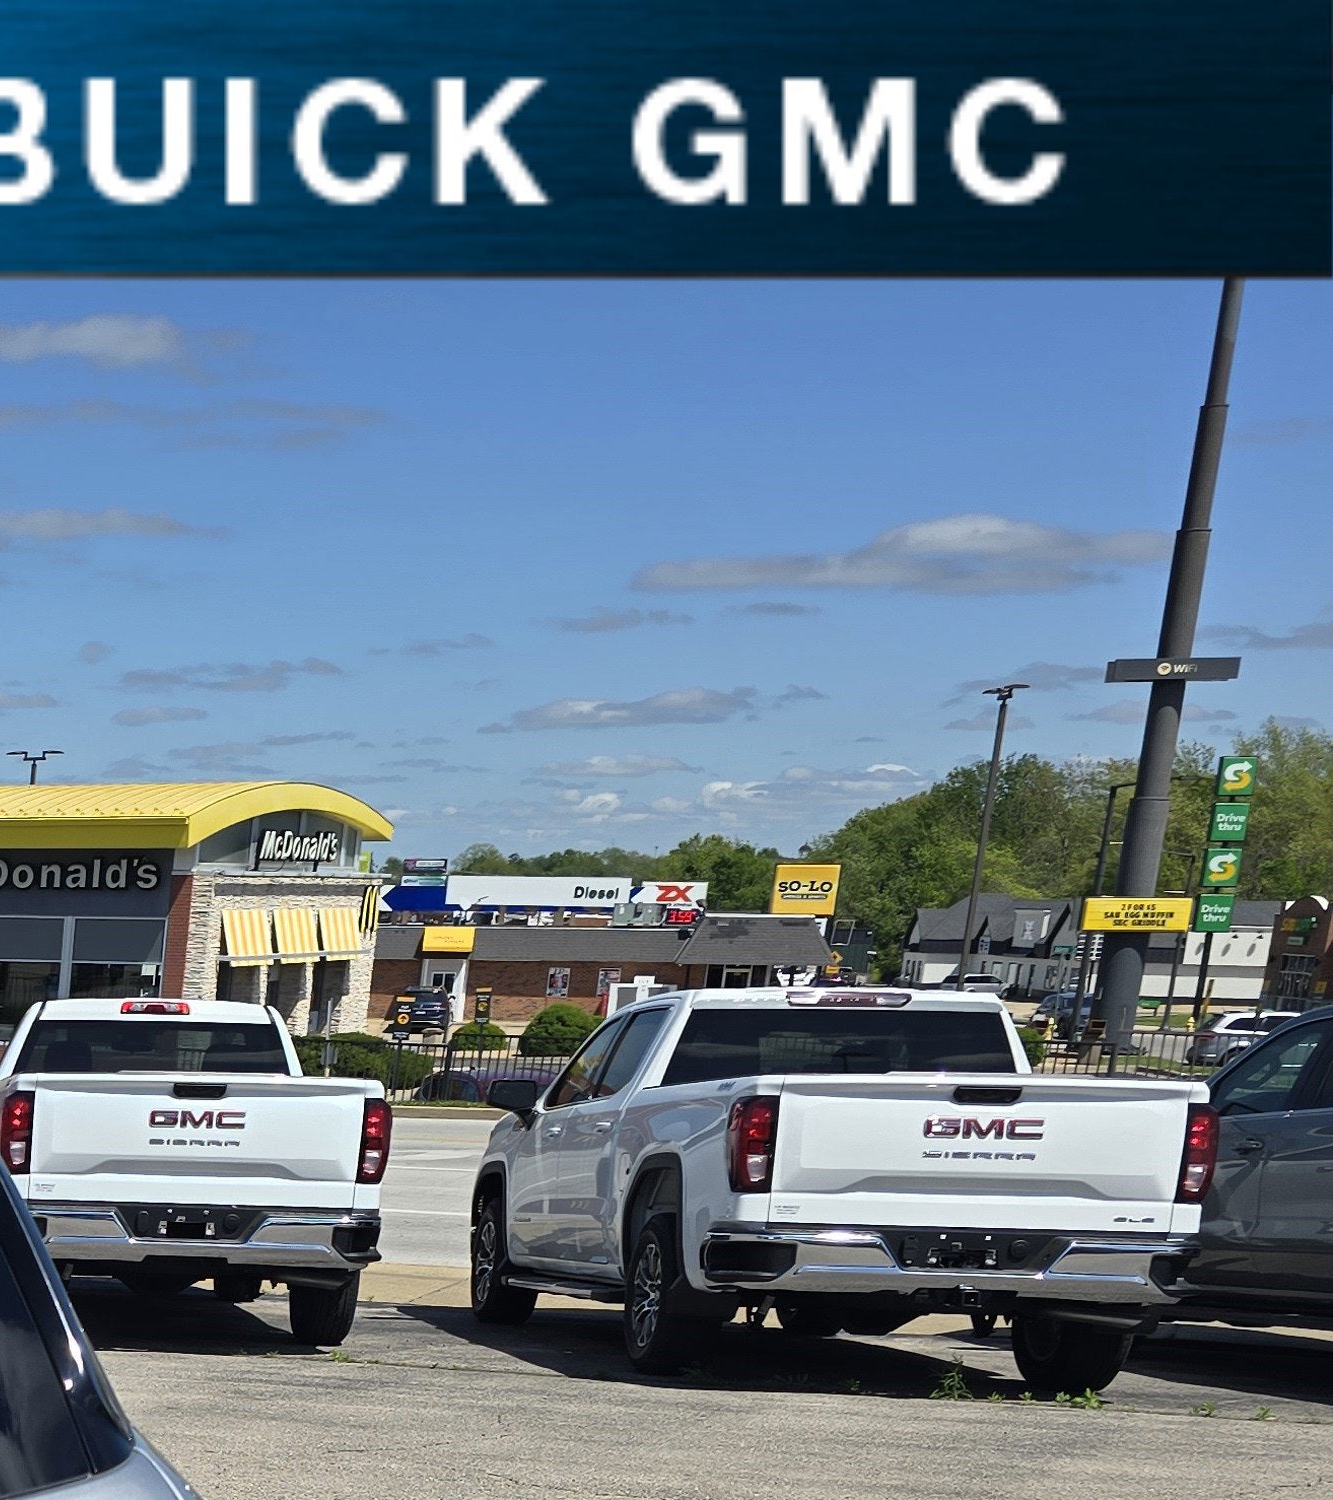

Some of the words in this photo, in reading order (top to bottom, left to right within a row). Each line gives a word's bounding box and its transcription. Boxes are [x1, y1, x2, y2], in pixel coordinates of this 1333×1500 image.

[1216, 813, 1246, 823] Drive
[1217, 822, 1243, 832] thru
[259, 830, 339, 861] McDonald's
[573, 886, 620, 900] Diesel
[777, 880, 833, 893] SO-LO
[1201, 903, 1231, 913] Drive
[1202, 913, 1227, 923] thru
[148, 1110, 247, 1130] GMC
[922, 1115, 1045, 1141] GMC
